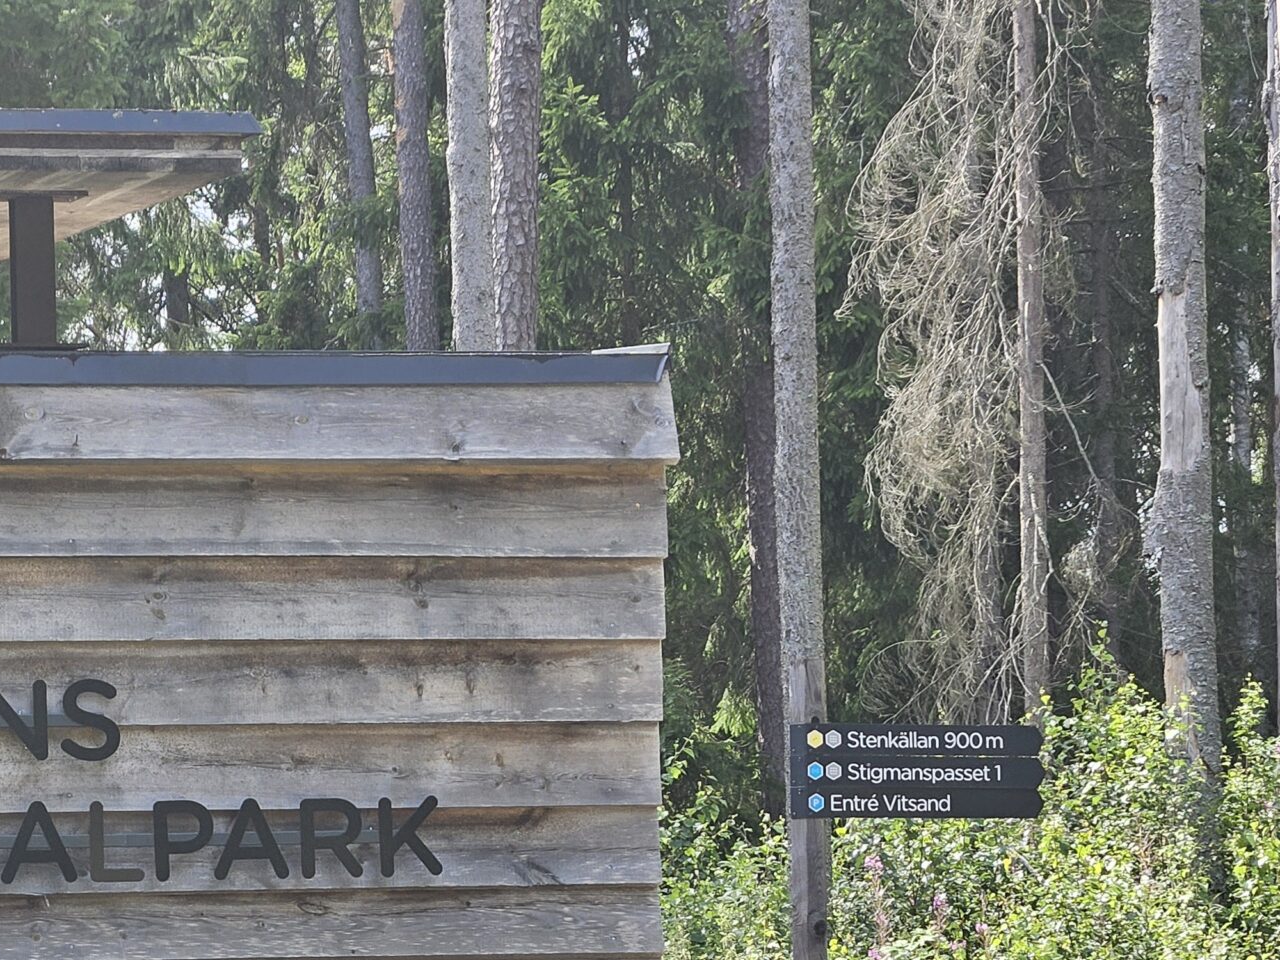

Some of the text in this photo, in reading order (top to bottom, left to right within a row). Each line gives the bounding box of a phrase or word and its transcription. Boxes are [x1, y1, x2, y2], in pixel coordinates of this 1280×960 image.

[847, 731, 1004, 749] Stenkällan 900 m
[847, 763, 1002, 784] Stigmanspasset 1
[830, 793, 951, 812] Entré Vitsand
